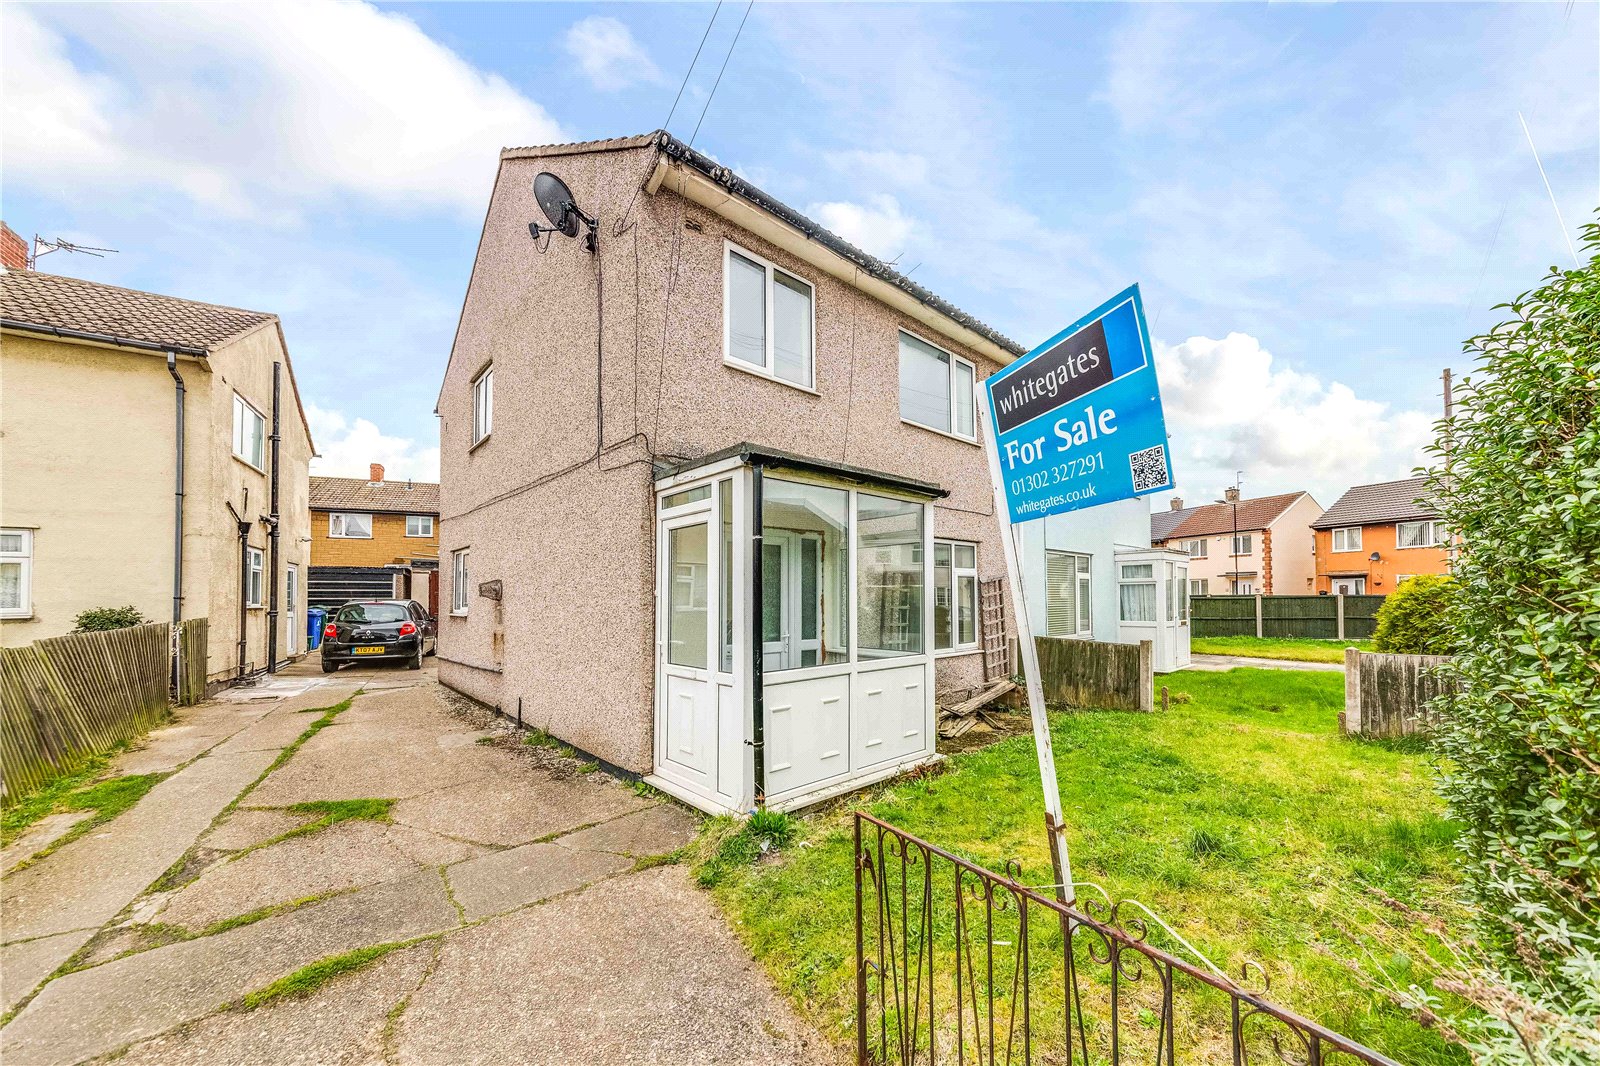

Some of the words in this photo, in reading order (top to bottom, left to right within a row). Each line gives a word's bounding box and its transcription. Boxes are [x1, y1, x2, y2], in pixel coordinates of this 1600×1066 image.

[999, 346, 1100, 415] whitegates
[1004, 435, 1046, 470] For
[1054, 405, 1118, 452] Sale
[1011, 470, 1050, 496] 01302
[1051, 451, 1104, 484] 327291
[1015, 482, 1097, 515] whitegates.co.uk
